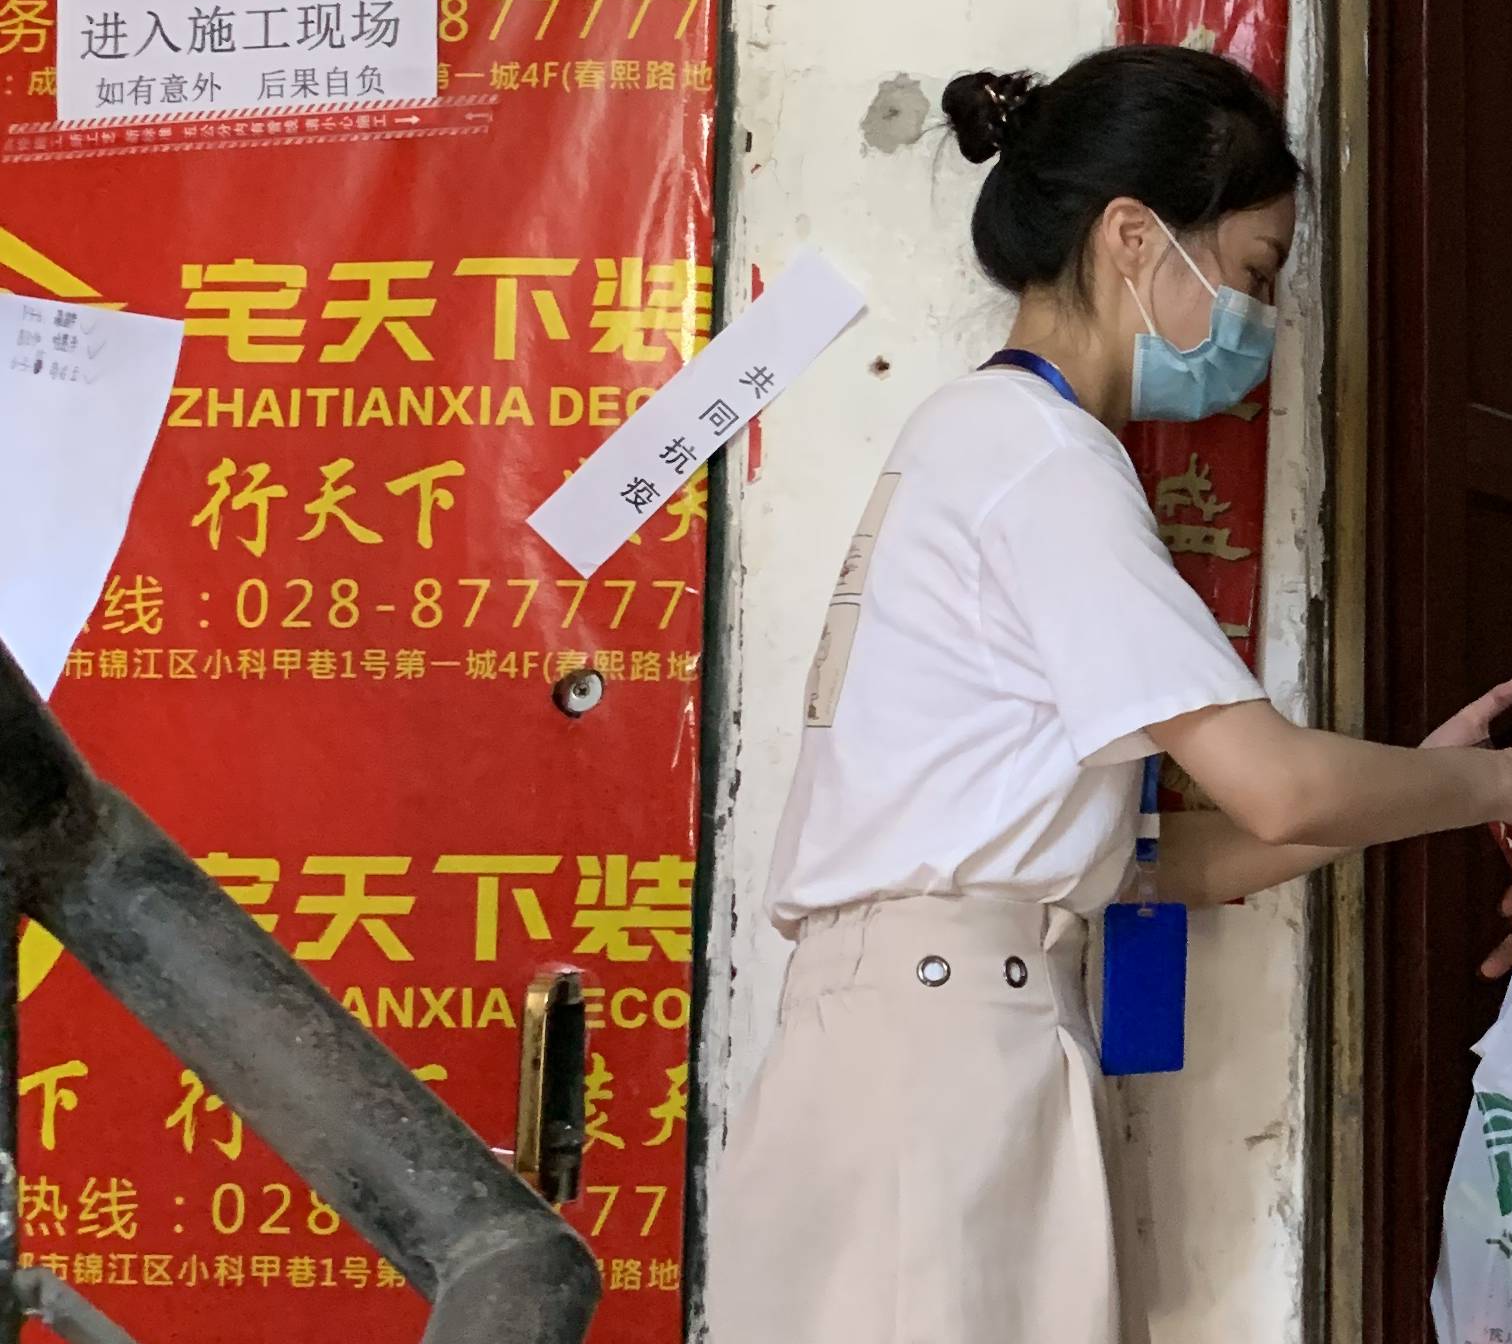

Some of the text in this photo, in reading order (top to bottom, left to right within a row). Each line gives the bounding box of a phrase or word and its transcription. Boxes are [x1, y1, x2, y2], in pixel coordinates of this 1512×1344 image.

[80, 0, 401, 60] 进入施工现场
[96, 64, 387, 109] 如有意外 后果自负
[181, 257, 713, 363] 宅天下装
[167, 386, 534, 427] ZHAITIANXIA
[620, 365, 775, 514] 共同抗疫
[191, 458, 466, 558] 行天下
[84, 575, 688, 635] 线:028-877777
